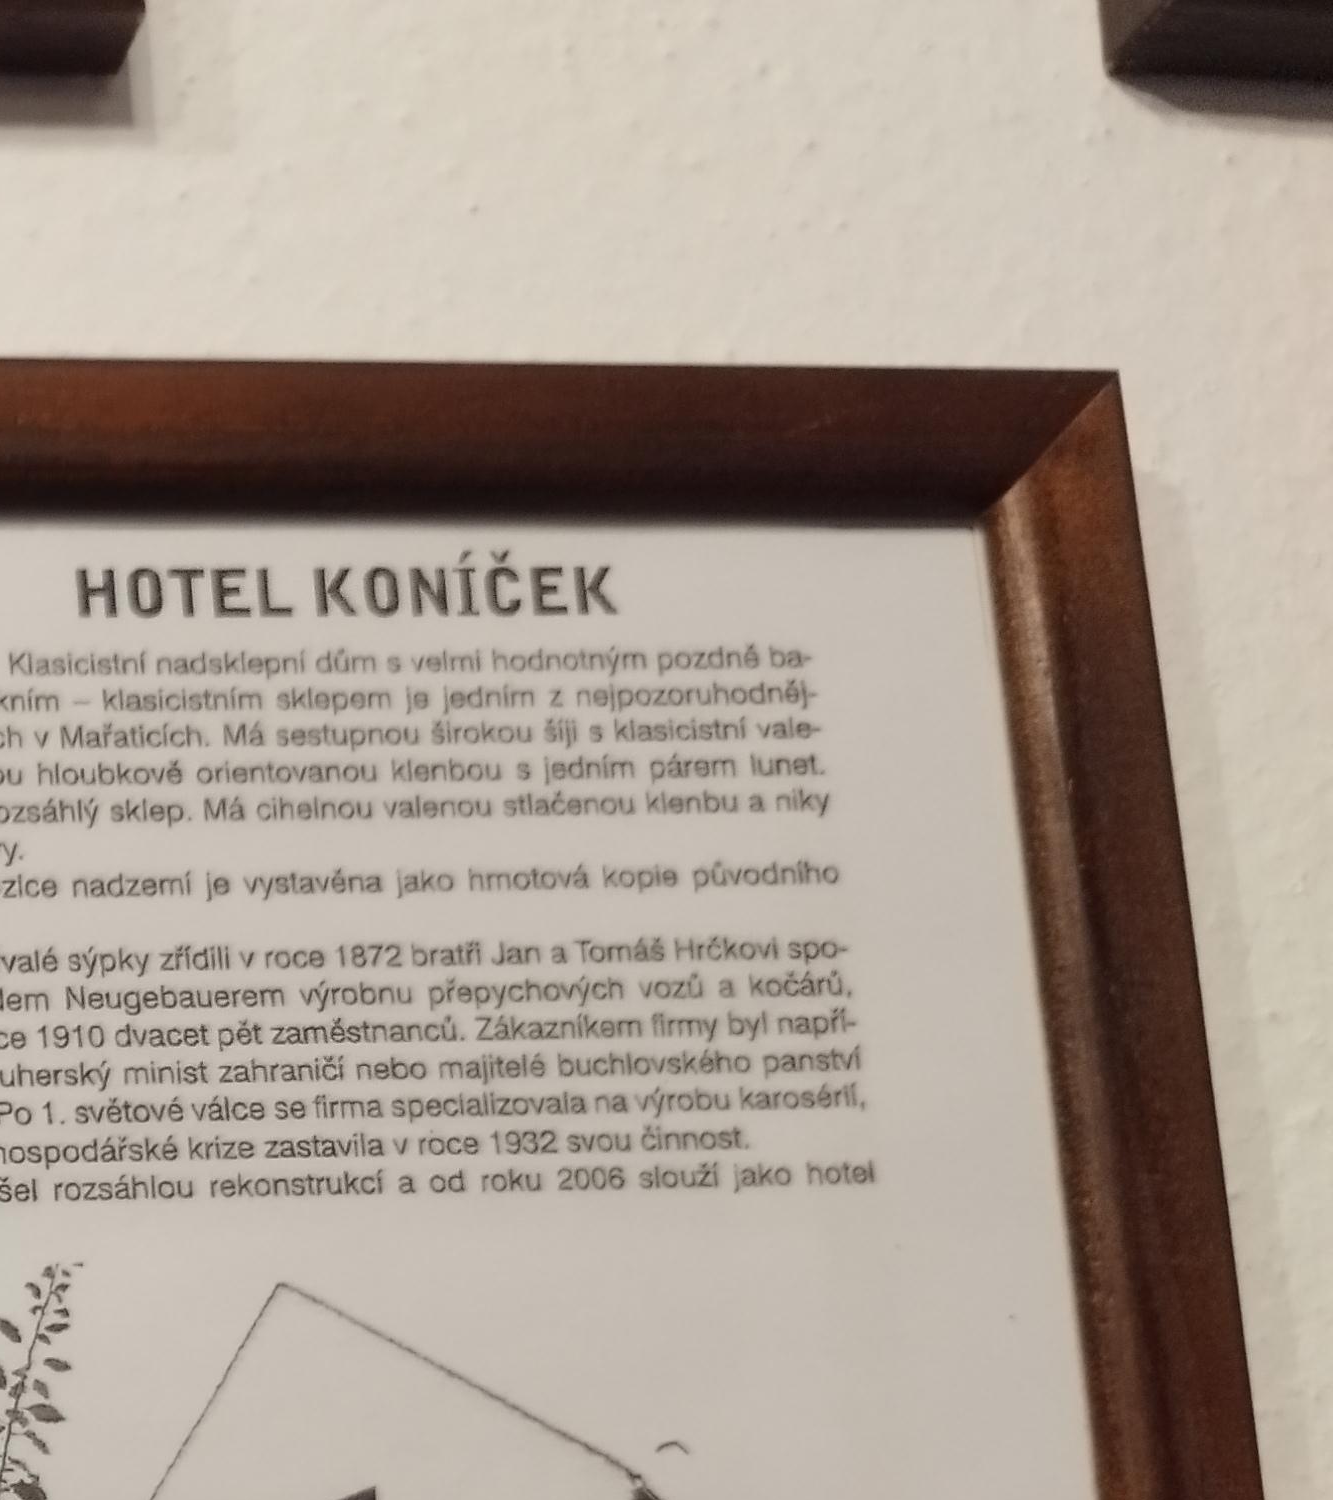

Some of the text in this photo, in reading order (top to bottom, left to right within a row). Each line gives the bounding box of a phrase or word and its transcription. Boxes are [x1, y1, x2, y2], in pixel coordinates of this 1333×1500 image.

[77, 548, 619, 619] HOTEL KONÍČEK
[8, 642, 813, 681] Klasicistní nadsklepní dům s velmi hodnotným pozdně ba-
[102, 686, 263, 713] klasicistním
[277, 686, 392, 716] sklepem
[406, 685, 431, 715] je
[443, 683, 535, 716] jedním
[549, 688, 564, 708] z
[576, 677, 818, 713] nejpozoruhodněj-
[33, 730, 50, 749] v
[59, 720, 210, 750] Mařaticích.
[223, 720, 266, 747] Má
[276, 722, 421, 753] sestupnou
[431, 718, 534, 745] širokou
[544, 717, 579, 750] šíji
[589, 724, 605, 743] s
[614, 716, 747, 742] klasicistní
[756, 716, 822, 741] vale-
[37, 759, 186, 787] hloubkově
[196, 758, 379, 785] orientovanou
[391, 756, 503, 783] klenbou
[516, 761, 533, 781] s
[544, 753, 636, 786] jedním
[649, 751, 738, 785] párem
[750, 752, 826, 778] lunet.
[110, 797, 192, 829] sklep.
[203, 795, 247, 822] Má
[256, 794, 374, 822] cihelnou
[383, 793, 494, 820] valenou
[503, 789, 637, 817] stlačenou
[645, 789, 741, 815] klenbu
[748, 793, 767, 813] a
[775, 786, 831, 819] niky
[72, 870, 192, 898] nadzemí
[206, 870, 232, 903] je
[243, 867, 385, 901] vystavěna
[396, 868, 456, 899] jako
[468, 863, 591, 892] hmotová
[602, 863, 679, 894] kopie
[692, 858, 841, 893] původního
[68, 945, 153, 980] sýpky
[158, 943, 232, 972] zřídili
[238, 950, 257, 969] v
[264, 948, 328, 970] roce
[335, 942, 404, 969] 1872
[411, 940, 483, 968] bratři
[491, 940, 543, 966] Jan
[550, 944, 570, 965] a
[573, 936, 667, 964] Tomáš
[674, 933, 781, 962] Hrčkovi
[787, 939, 849, 967] spo-
[65, 981, 286, 1017] Neugebauerem
[299, 977, 414, 1013] výrobnu
[428, 974, 625, 1011] přepychových
[639, 973, 705, 1000] vozů
[718, 978, 737, 999] a
[748, 970, 853, 1000] kočárů,
[37, 1023, 108, 1050] 1910
[114, 1021, 216, 1049] dvacet
[217, 1017, 264, 1055] pět
[269, 1015, 467, 1045] zaměstnanců.
[474, 1012, 644, 1042] Zákazníkem
[651, 1010, 720, 1044] firmy
[727, 1009, 769, 1042] byl
[776, 1007, 857, 1040] napří-
[123, 1058, 213, 1086] minist
[217, 1054, 348, 1084] zahraničí
[355, 1055, 429, 1081] nebo
[438, 1052, 548, 1086] majitelé
[557, 1047, 752, 1077] buchlovského
[762, 1045, 862, 1079] panství
[41, 1100, 66, 1126] 1.
[74, 1096, 184, 1125] světové
[191, 1094, 266, 1122] válce
[274, 1099, 309, 1120] se
[311, 1093, 385, 1120] firma
[391, 1089, 590, 1124] specializovala
[594, 1093, 631, 1114] na
[634, 1085, 732, 1119] výrobu
[188, 1134, 257, 1161] krize
[263, 1131, 389, 1159] zastavila
[392, 1137, 411, 1156] v
[418, 1135, 482, 1157] roce
[490, 1129, 560, 1155] 1932
[566, 1132, 634, 1154] svou
[640, 1123, 750, 1152] činnost.
[52, 1173, 194, 1201] rozsáhlou
[210, 1168, 385, 1199] rekonstrukcí
[398, 1173, 418, 1195] a
[429, 1168, 469, 1194] od
[481, 1167, 544, 1193] roku
[557, 1165, 628, 1192] 2006
[639, 1162, 721, 1191] slouží
[734, 1162, 793, 1193] jako
[806, 1160, 877, 1186] hotel
